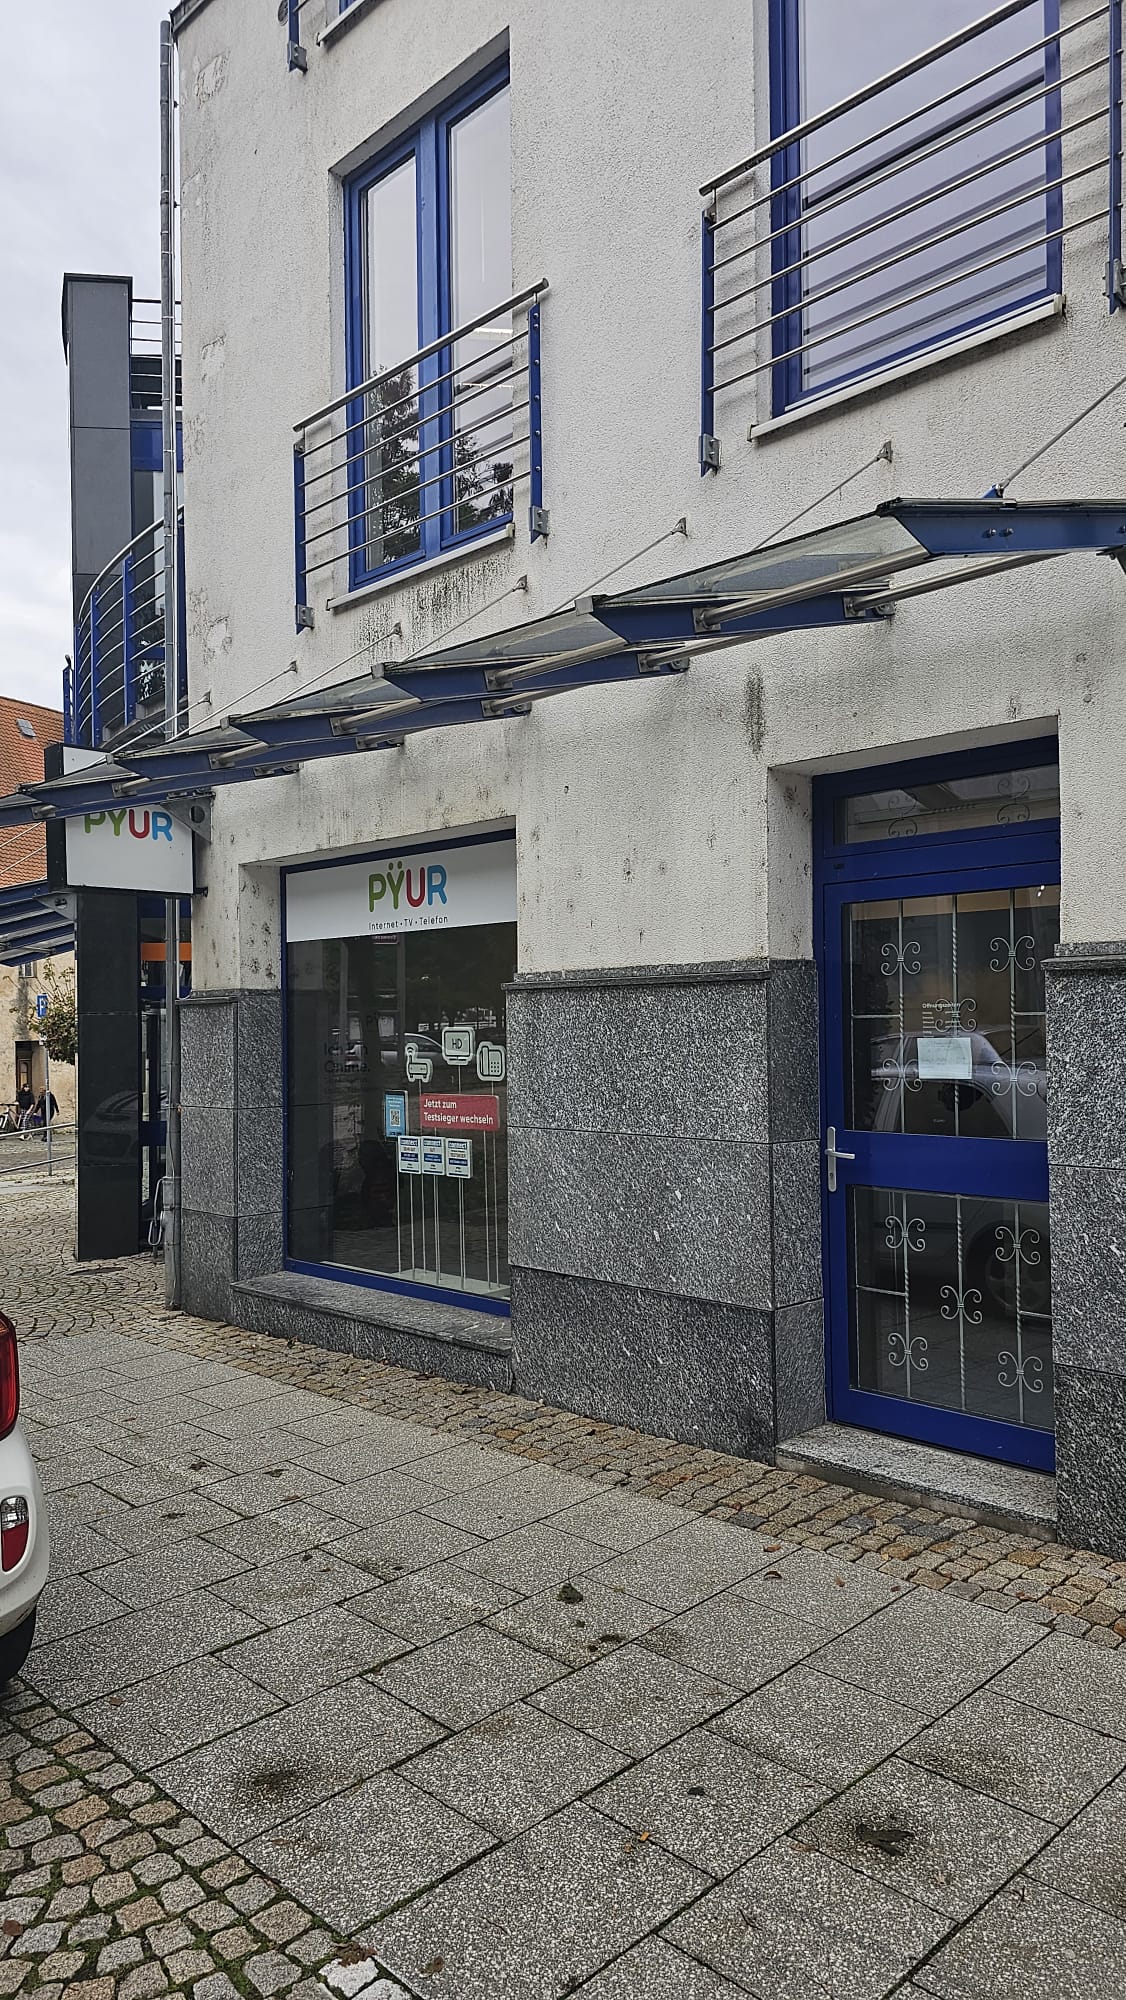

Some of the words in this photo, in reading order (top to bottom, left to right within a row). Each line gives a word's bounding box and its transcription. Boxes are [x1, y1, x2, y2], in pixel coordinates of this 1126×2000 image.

[368, 860, 448, 912] PŸUR
[369, 920, 398, 931] Internet
[404, 918, 413, 927] TV
[420, 915, 448, 925] Telefon
[452, 1038, 462, 1050] HD
[423, 1099, 441, 1109] Jetzt
[442, 1101, 457, 1109] zum
[423, 1112, 459, 1124] Testsieger
[460, 1113, 494, 1125] wechseln
